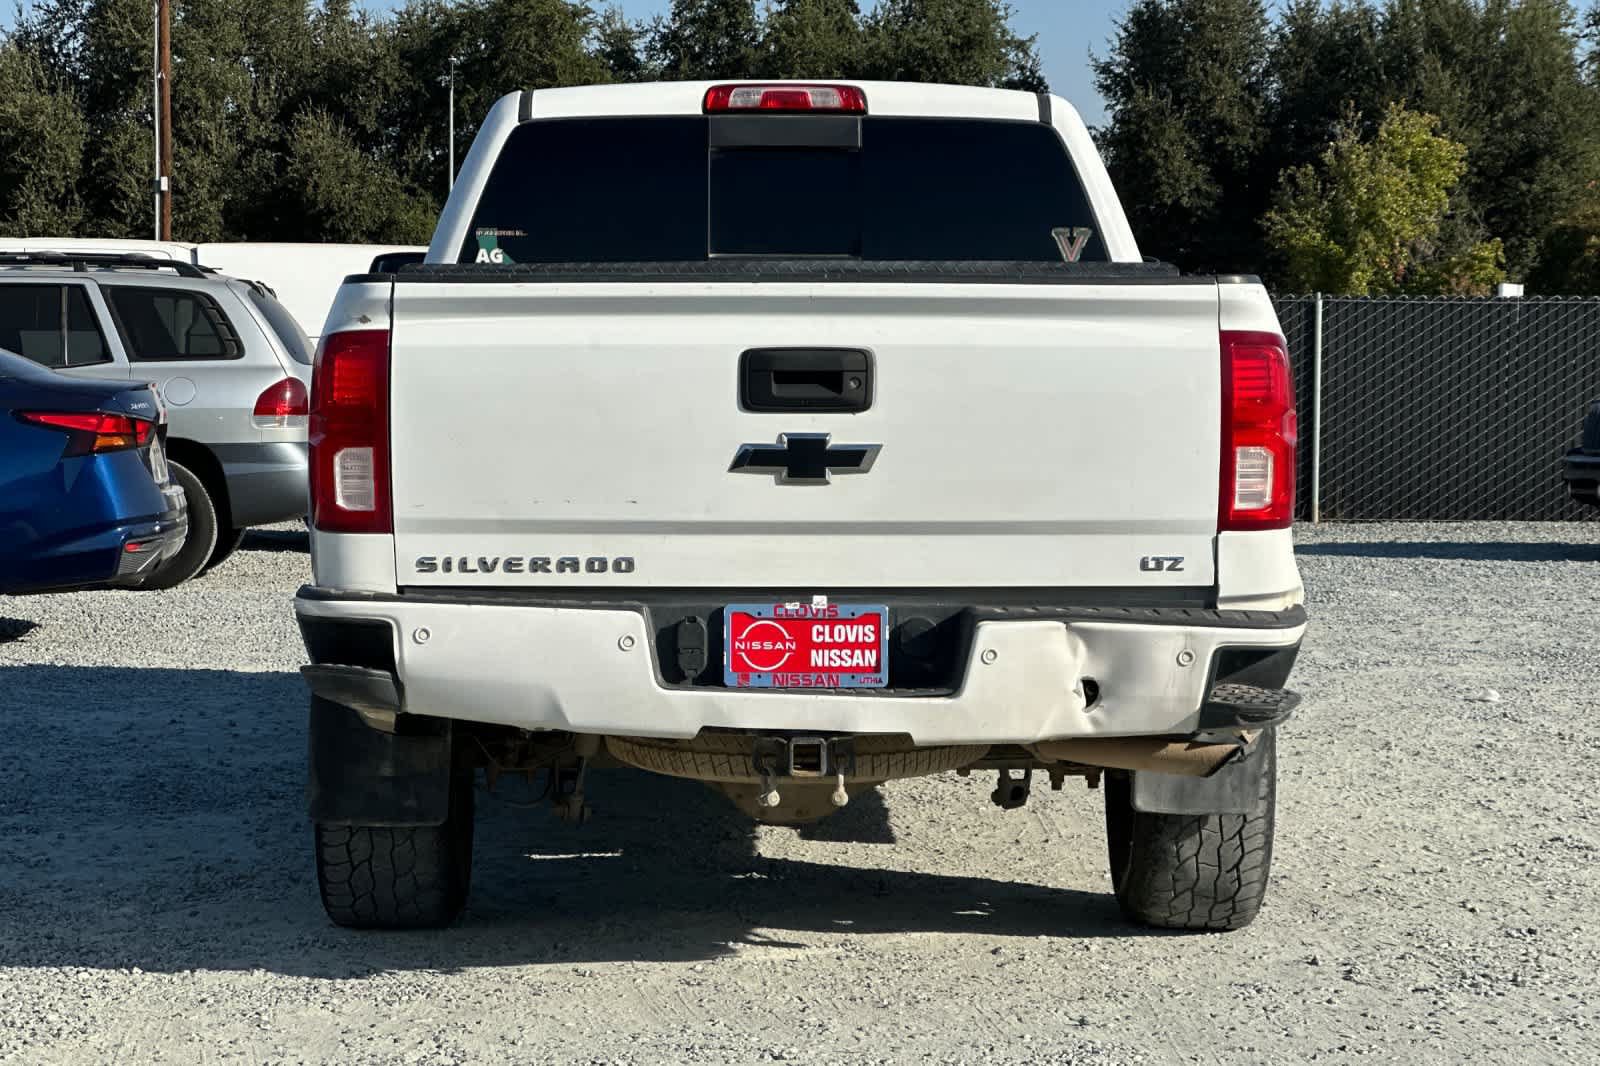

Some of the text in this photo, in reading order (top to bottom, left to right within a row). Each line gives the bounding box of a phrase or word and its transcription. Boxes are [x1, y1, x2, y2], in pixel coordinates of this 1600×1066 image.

[1051, 227, 1092, 262] V
[475, 248, 503, 264] AG
[415, 556, 635, 574] SILVERADO
[1140, 556, 1184, 571] LTZ
[773, 604, 839, 618] CLOVIS
[811, 624, 876, 643] CLOVIS
[735, 641, 796, 650] NISSAN
[810, 649, 877, 667] NISSAN
[772, 673, 840, 687] NISSAN
